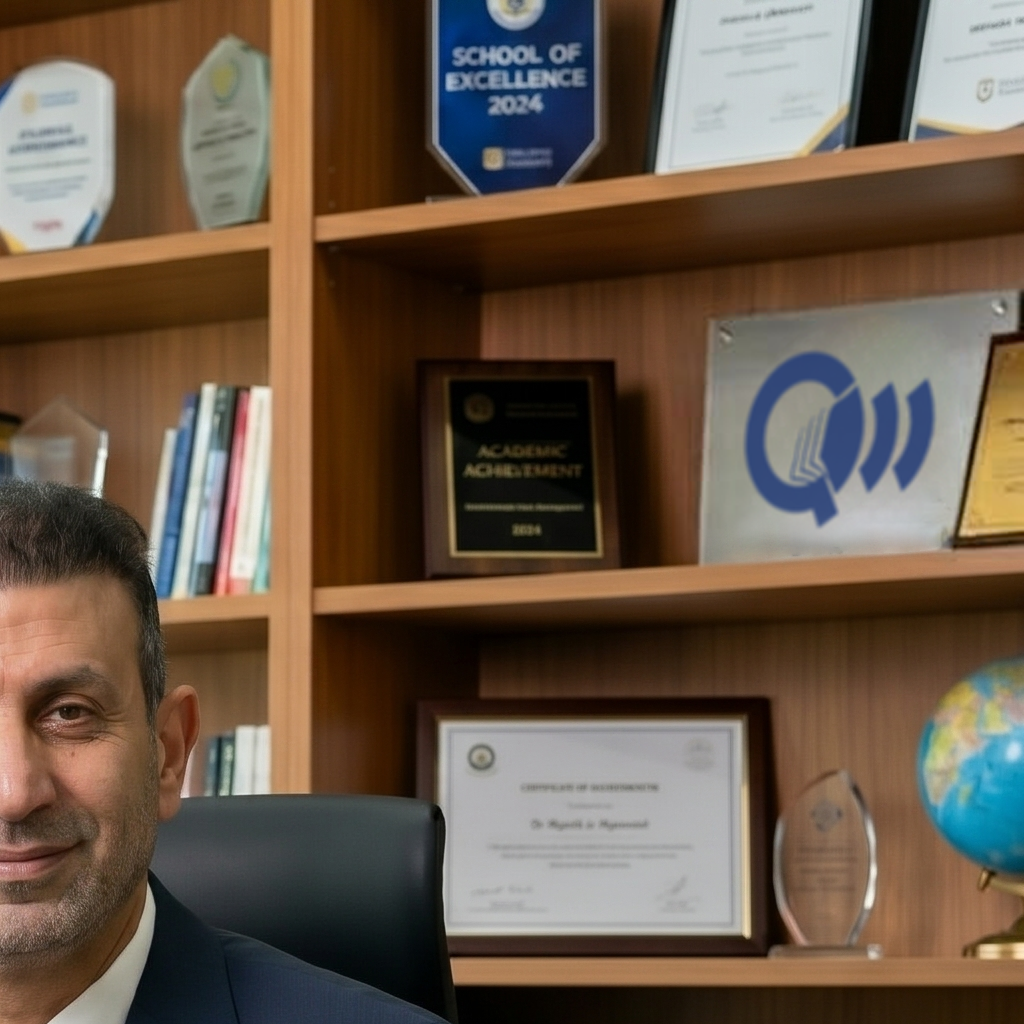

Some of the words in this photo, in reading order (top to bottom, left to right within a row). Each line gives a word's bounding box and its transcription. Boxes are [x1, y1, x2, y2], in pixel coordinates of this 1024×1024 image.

[452, 44, 543, 67] SCHOOL
[548, 42, 582, 65] OF
[445, 68, 588, 92] EXCELLENCE
[488, 93, 544, 116] 2024
[477, 443, 568, 459] ACADEMIC
